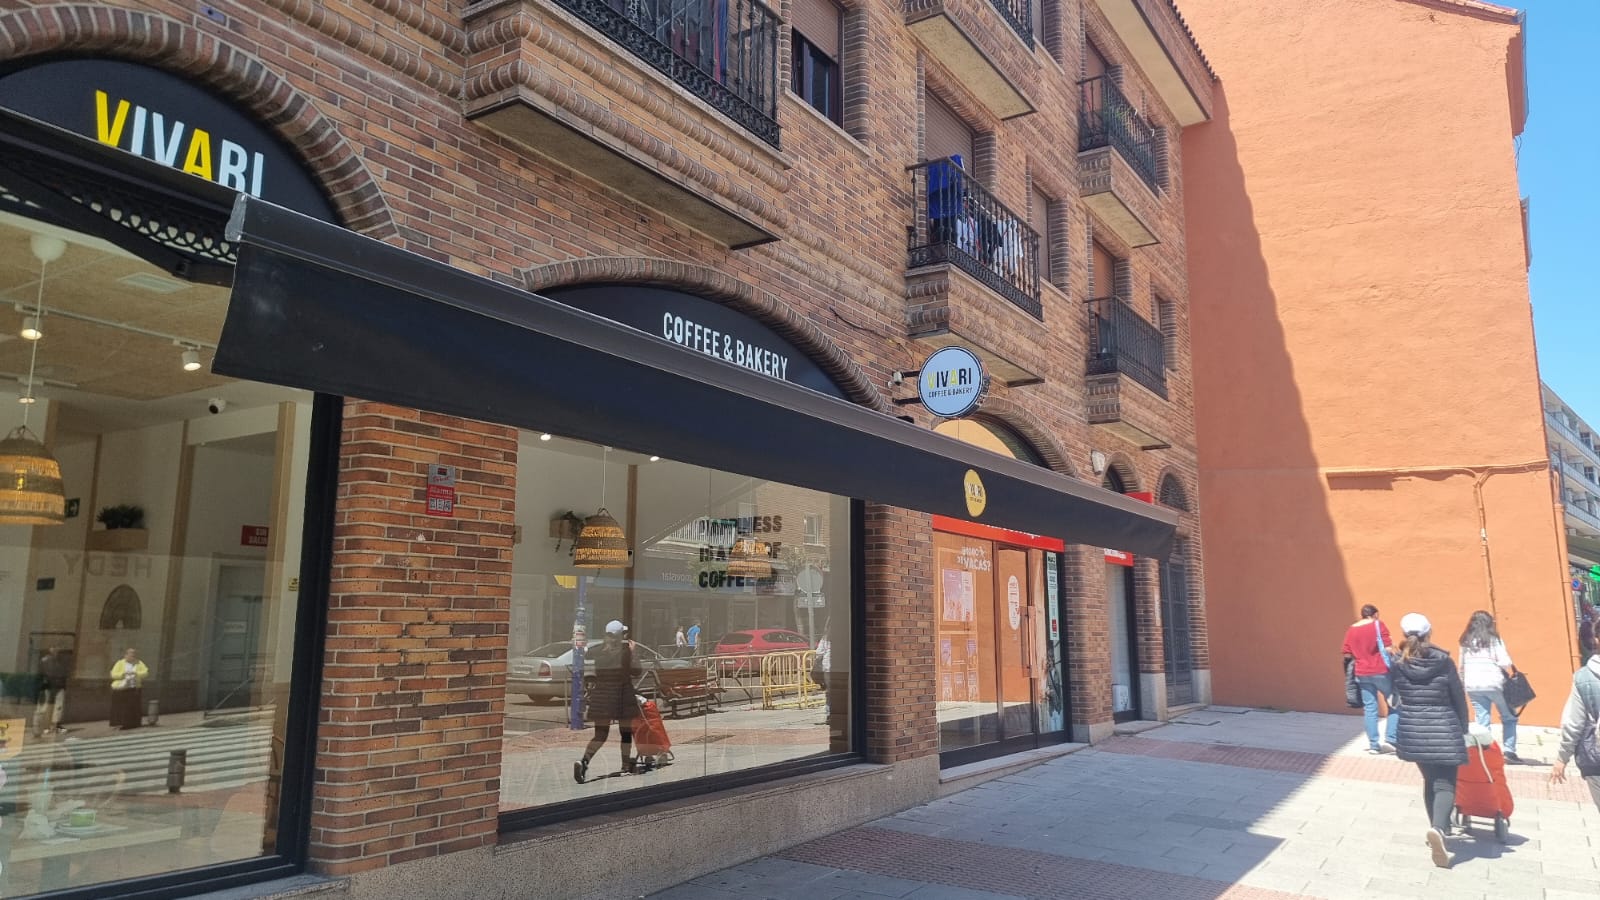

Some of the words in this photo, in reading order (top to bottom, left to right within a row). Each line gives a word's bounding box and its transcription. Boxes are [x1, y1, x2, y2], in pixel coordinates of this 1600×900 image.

[95, 89, 265, 198] VIVARI
[663, 311, 721, 358] COFFEE
[723, 334, 734, 362] &
[736, 339, 788, 381] BAKERY
[927, 367, 972, 390] VIVARI
[928, 389, 947, 398] COFFEE
[952, 386, 973, 396] BAKERY
